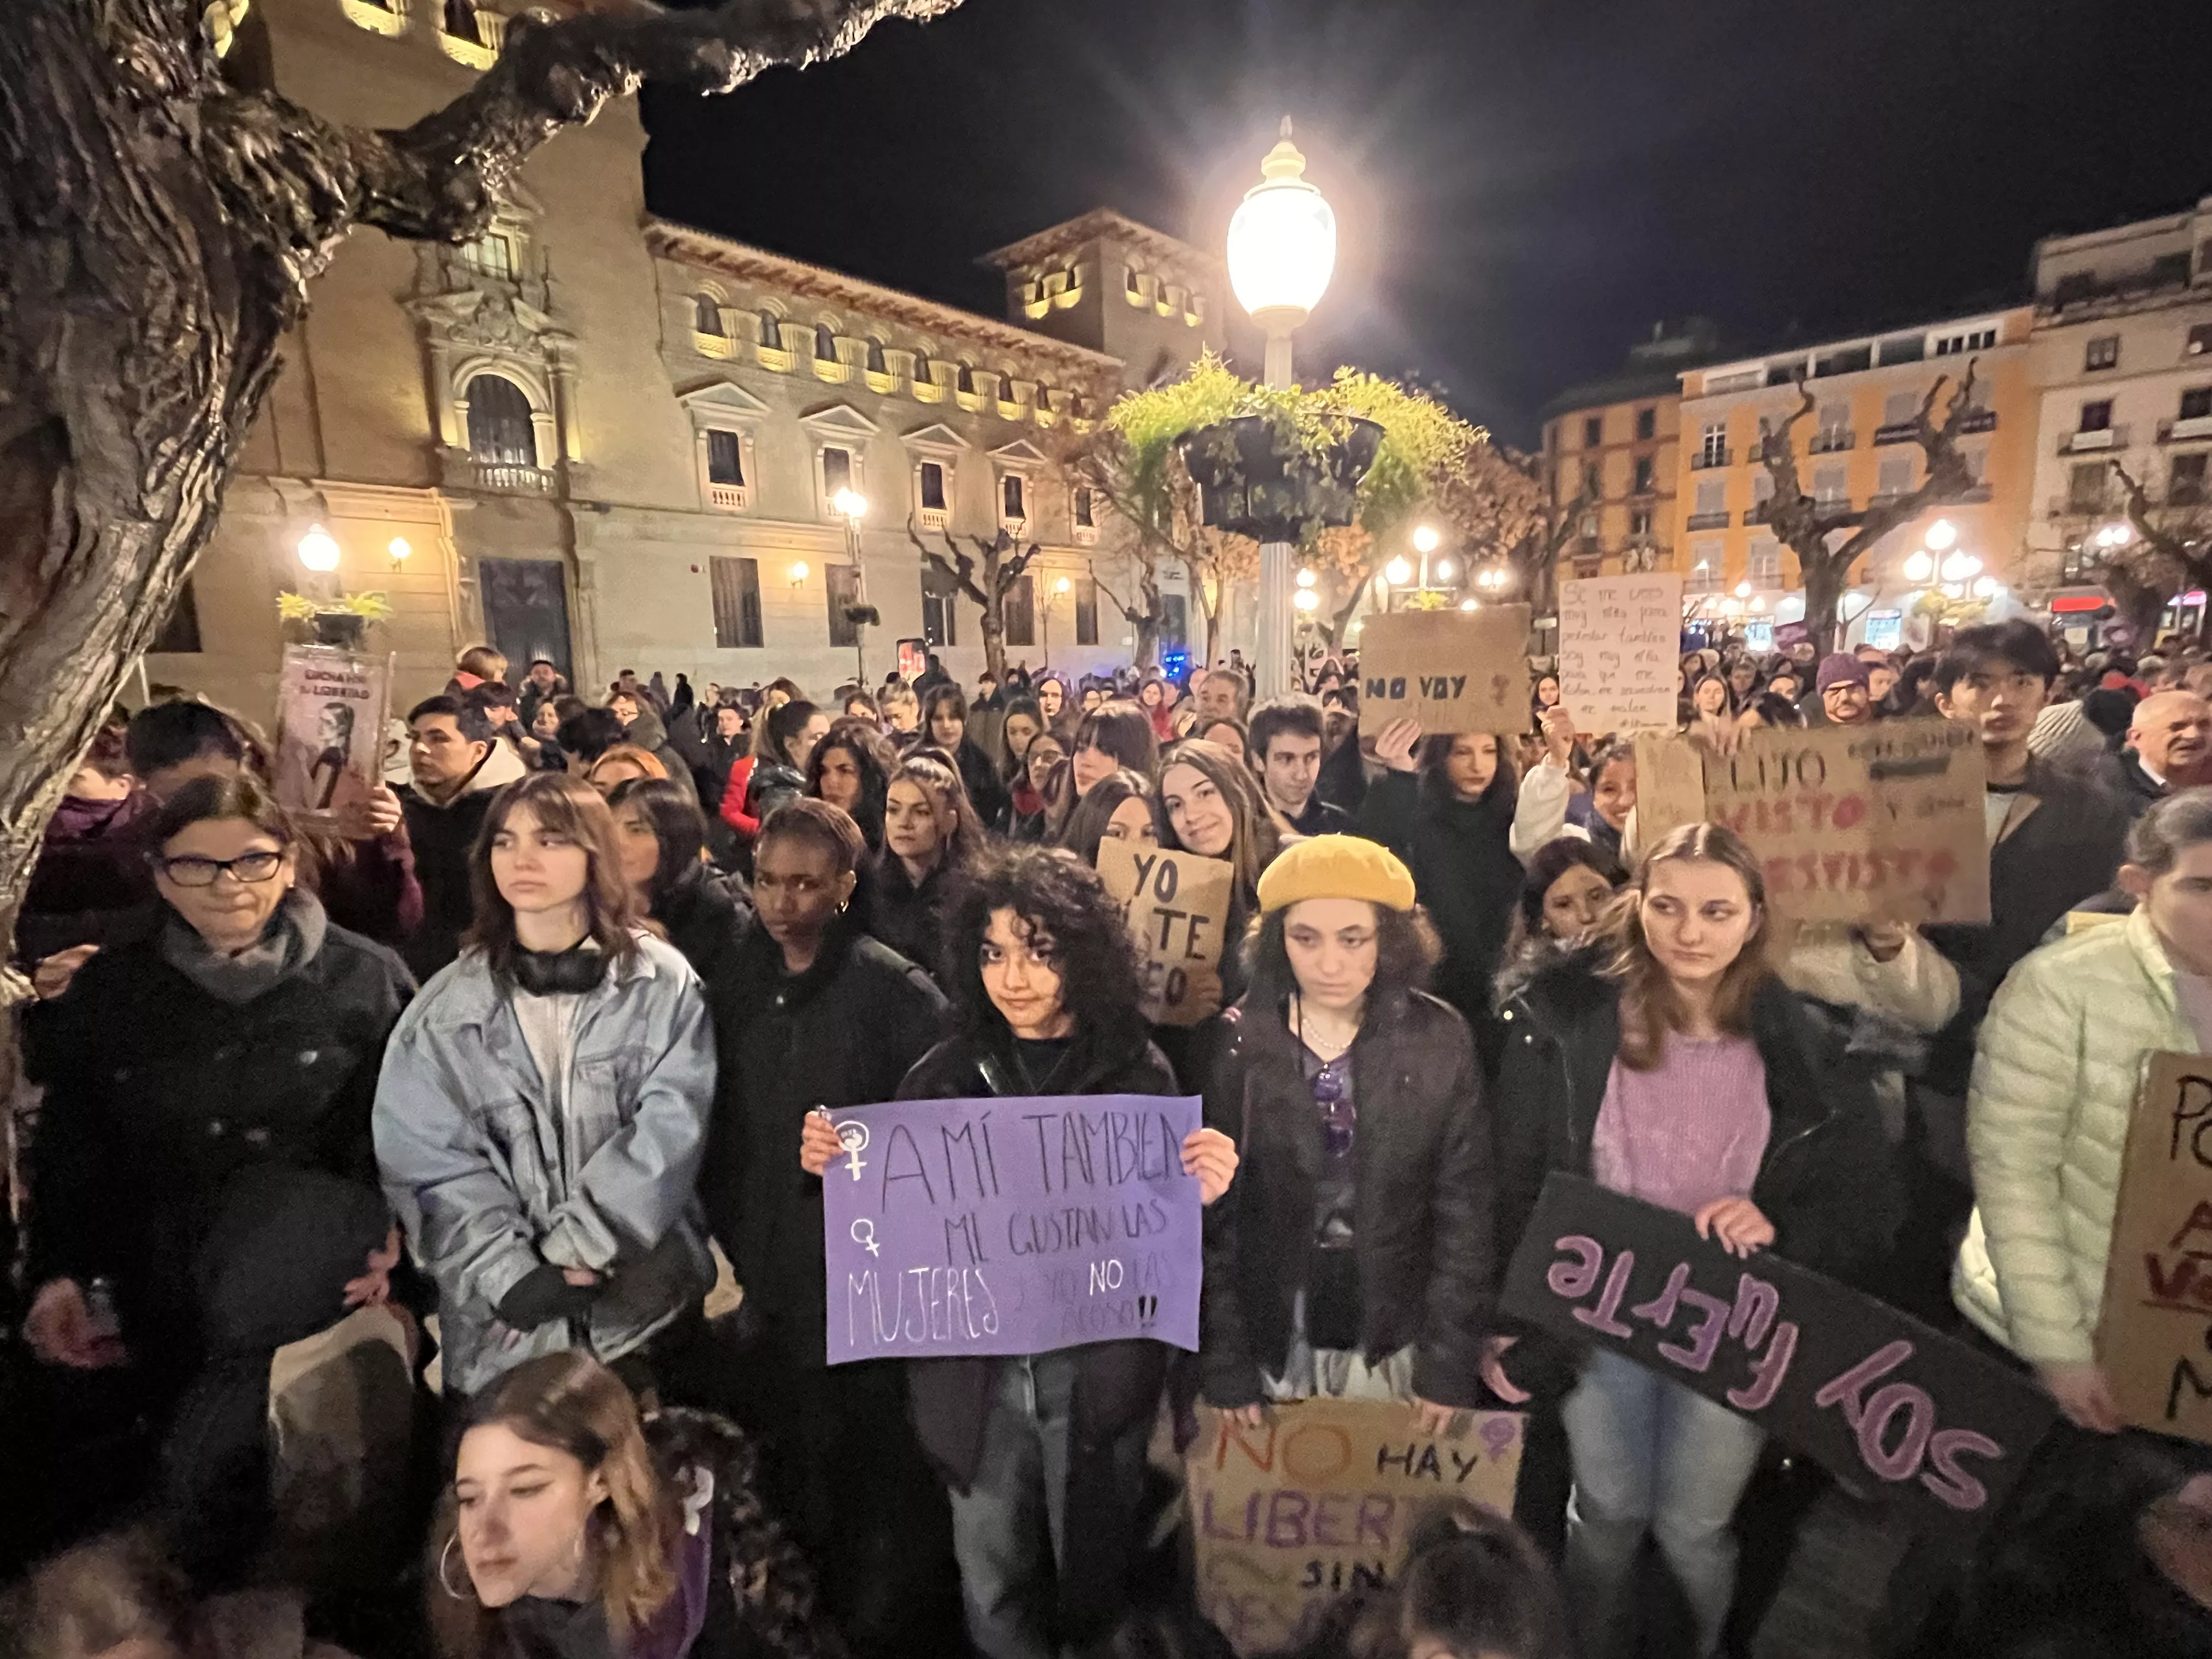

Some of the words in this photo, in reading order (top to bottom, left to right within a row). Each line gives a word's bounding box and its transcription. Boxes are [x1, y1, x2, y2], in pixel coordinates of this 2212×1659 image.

[1365, 676, 1406, 700] NO
[1419, 674, 1467, 700] VOY
[1133, 853, 1178, 904] YO
[1763, 847, 1960, 895] ESVISTO
[1154, 906, 1210, 961] TE
[882, 1124, 935, 1214] A
[941, 1110, 999, 1200] MÍ
[1008, 1207, 1113, 1256] GUSTAN
[1122, 1198, 1167, 1238] LAS
[849, 1267, 999, 1347] MUJERES
[1090, 1259, 1123, 1296] NO
[1215, 1421, 1352, 1484] NO
[1376, 1442, 1479, 1483] HAY
[1201, 1489, 1422, 1552] LIBER
[1301, 1559, 1387, 1593] SIN
